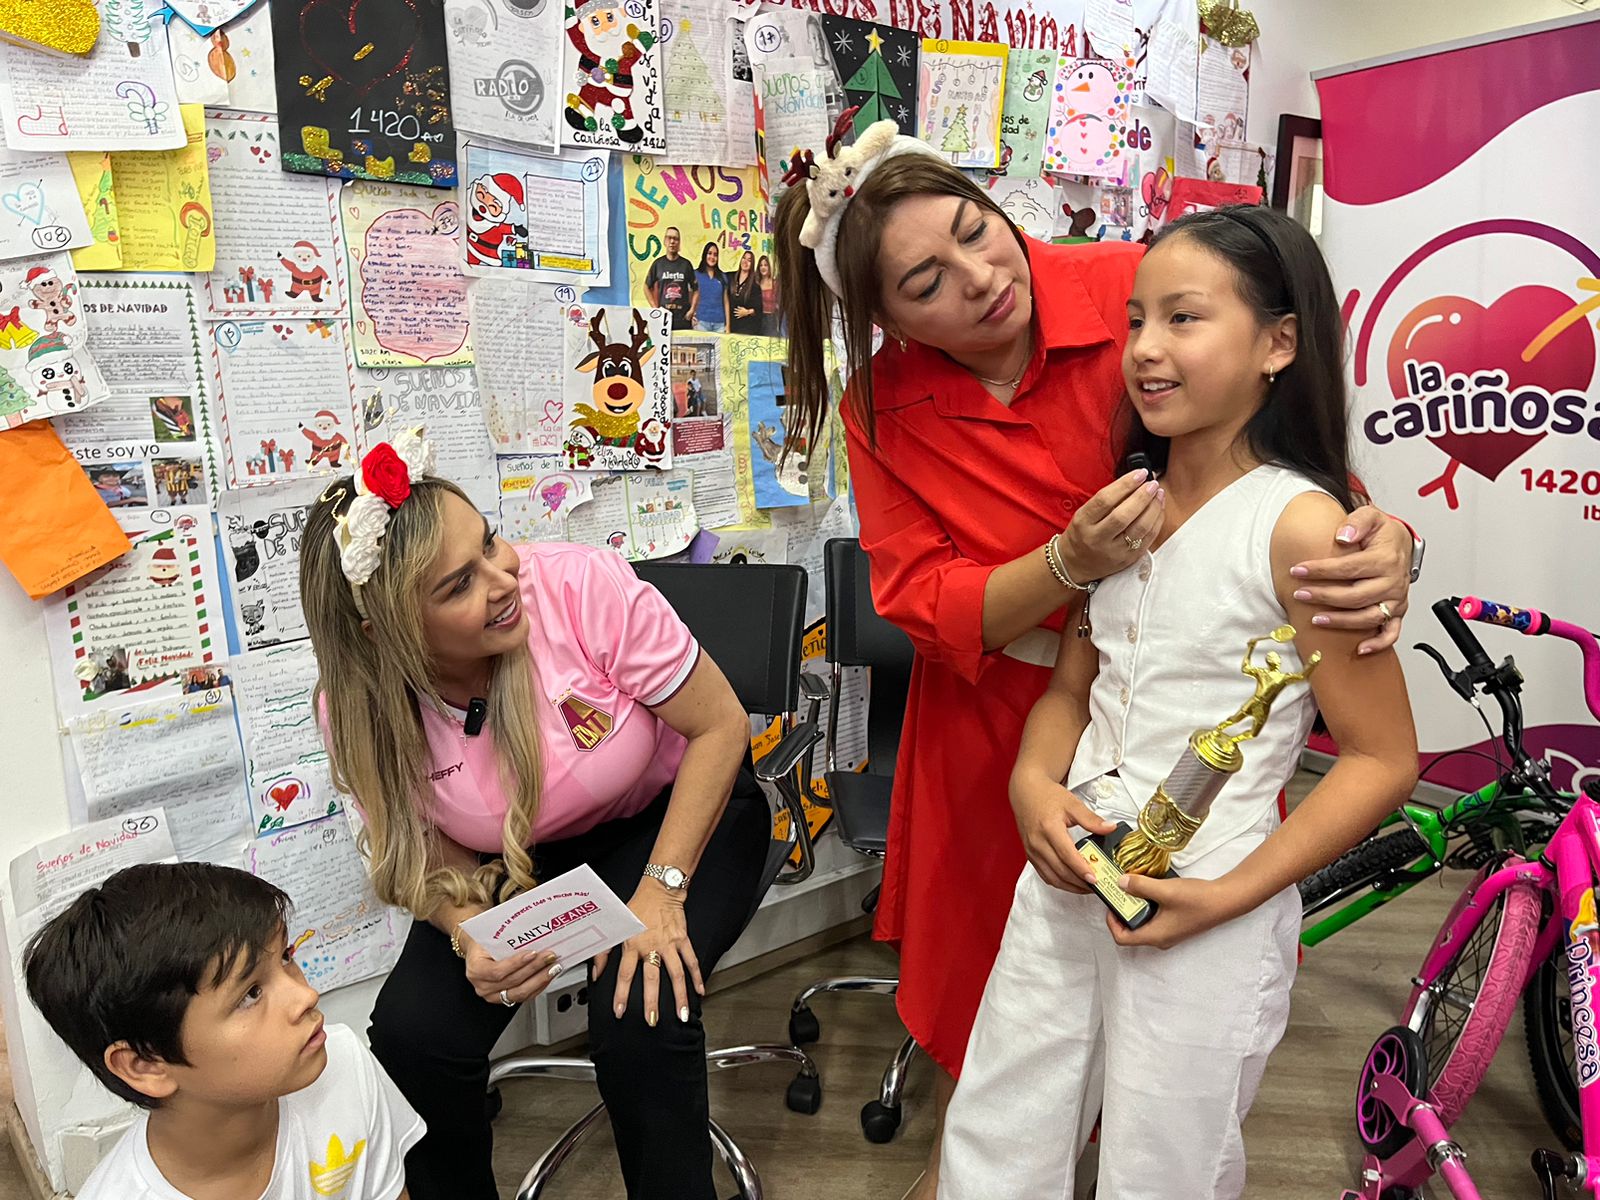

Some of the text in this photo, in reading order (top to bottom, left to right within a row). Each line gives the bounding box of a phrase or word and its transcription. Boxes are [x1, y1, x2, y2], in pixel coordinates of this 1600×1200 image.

[759, 30, 776, 46] 17
[348, 108, 420, 141] 1420
[1019, 114, 1030, 125] de
[1126, 119, 1152, 151] de
[701, 203, 722, 230] LA
[37, 226, 67, 246] 108
[717, 229, 757, 251] 1420
[558, 287, 571, 300] 19
[100, 303, 114, 314] DE
[117, 303, 168, 314] NAVIDAD
[1405, 362, 1442, 396] la
[106, 445, 136, 464] soy
[139, 444, 160, 461] yo
[540, 460, 551, 470] de
[1520, 467, 1600, 496] 1420
[264, 537, 287, 560] DE
[127, 817, 150, 831] 56
[36, 831, 139, 874] Sueños de Navidad
